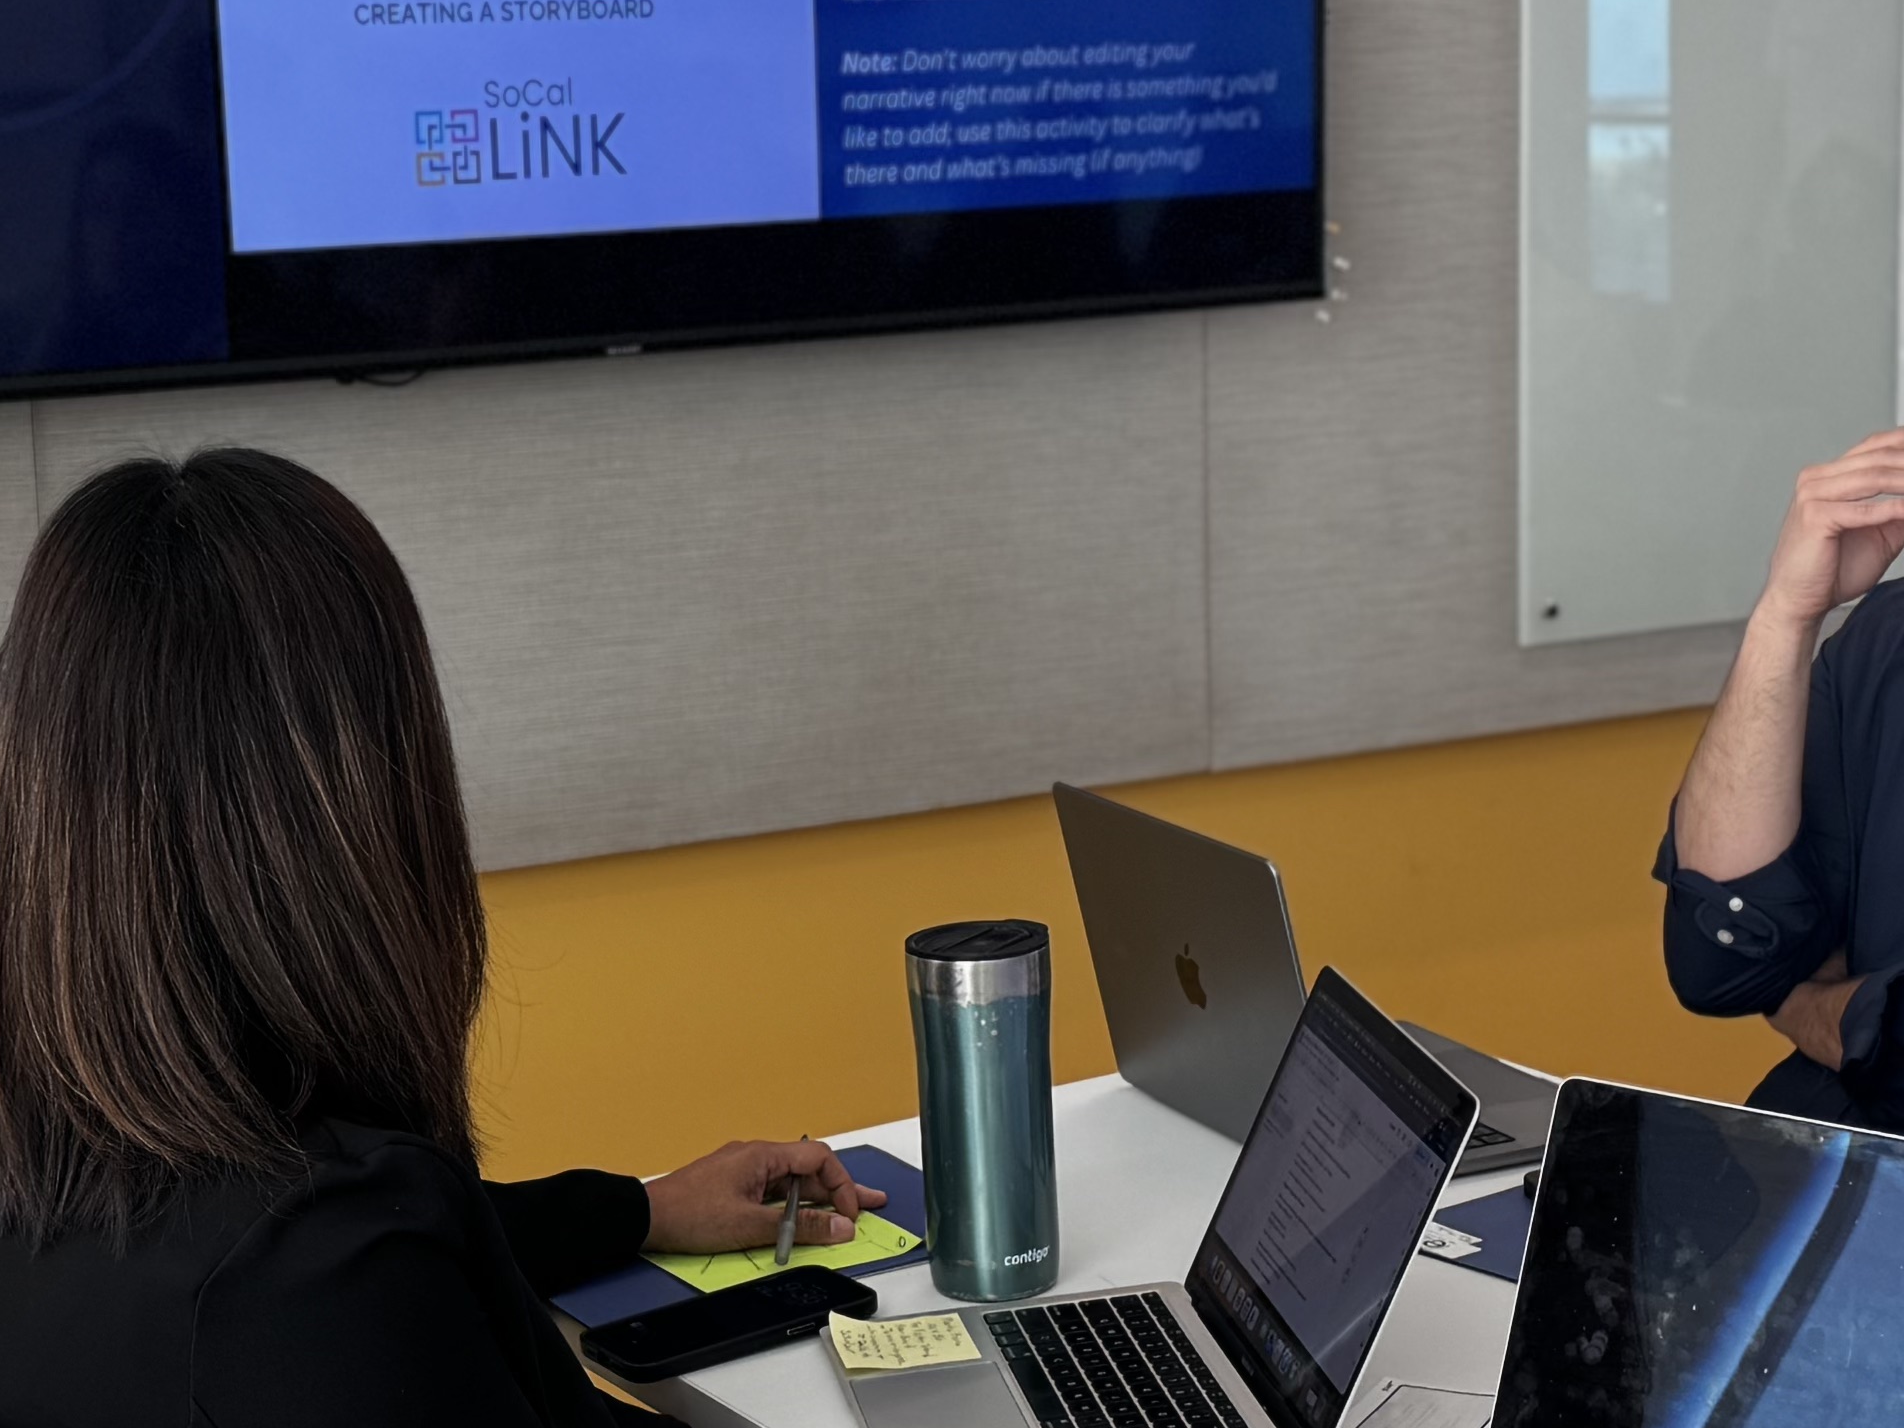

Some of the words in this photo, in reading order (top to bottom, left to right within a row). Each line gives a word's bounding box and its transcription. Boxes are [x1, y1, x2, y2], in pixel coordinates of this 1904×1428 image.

[354, 1, 474, 26] CREATING
[479, 1, 496, 24] A
[842, 51, 899, 74] Note:
[962, 50, 1016, 76] worry
[1022, 45, 1079, 68] about
[1083, 45, 1147, 70] editing
[1152, 42, 1194, 67] your
[484, 77, 573, 109] SoCal
[843, 85, 935, 111] narrative
[941, 83, 982, 111] right
[990, 83, 1031, 104] now
[1052, 77, 1103, 102] there
[1127, 74, 1223, 102] something
[845, 123, 877, 149] like
[884, 126, 904, 148] to
[957, 123, 991, 145] use
[996, 119, 1031, 142] this
[1036, 115, 1107, 142] activity
[1112, 116, 1131, 136] to
[845, 162, 899, 186] there
[904, 160, 941, 182] and
[1016, 152, 1086, 179] missing
[1004, 1245, 1050, 1266] contigo
